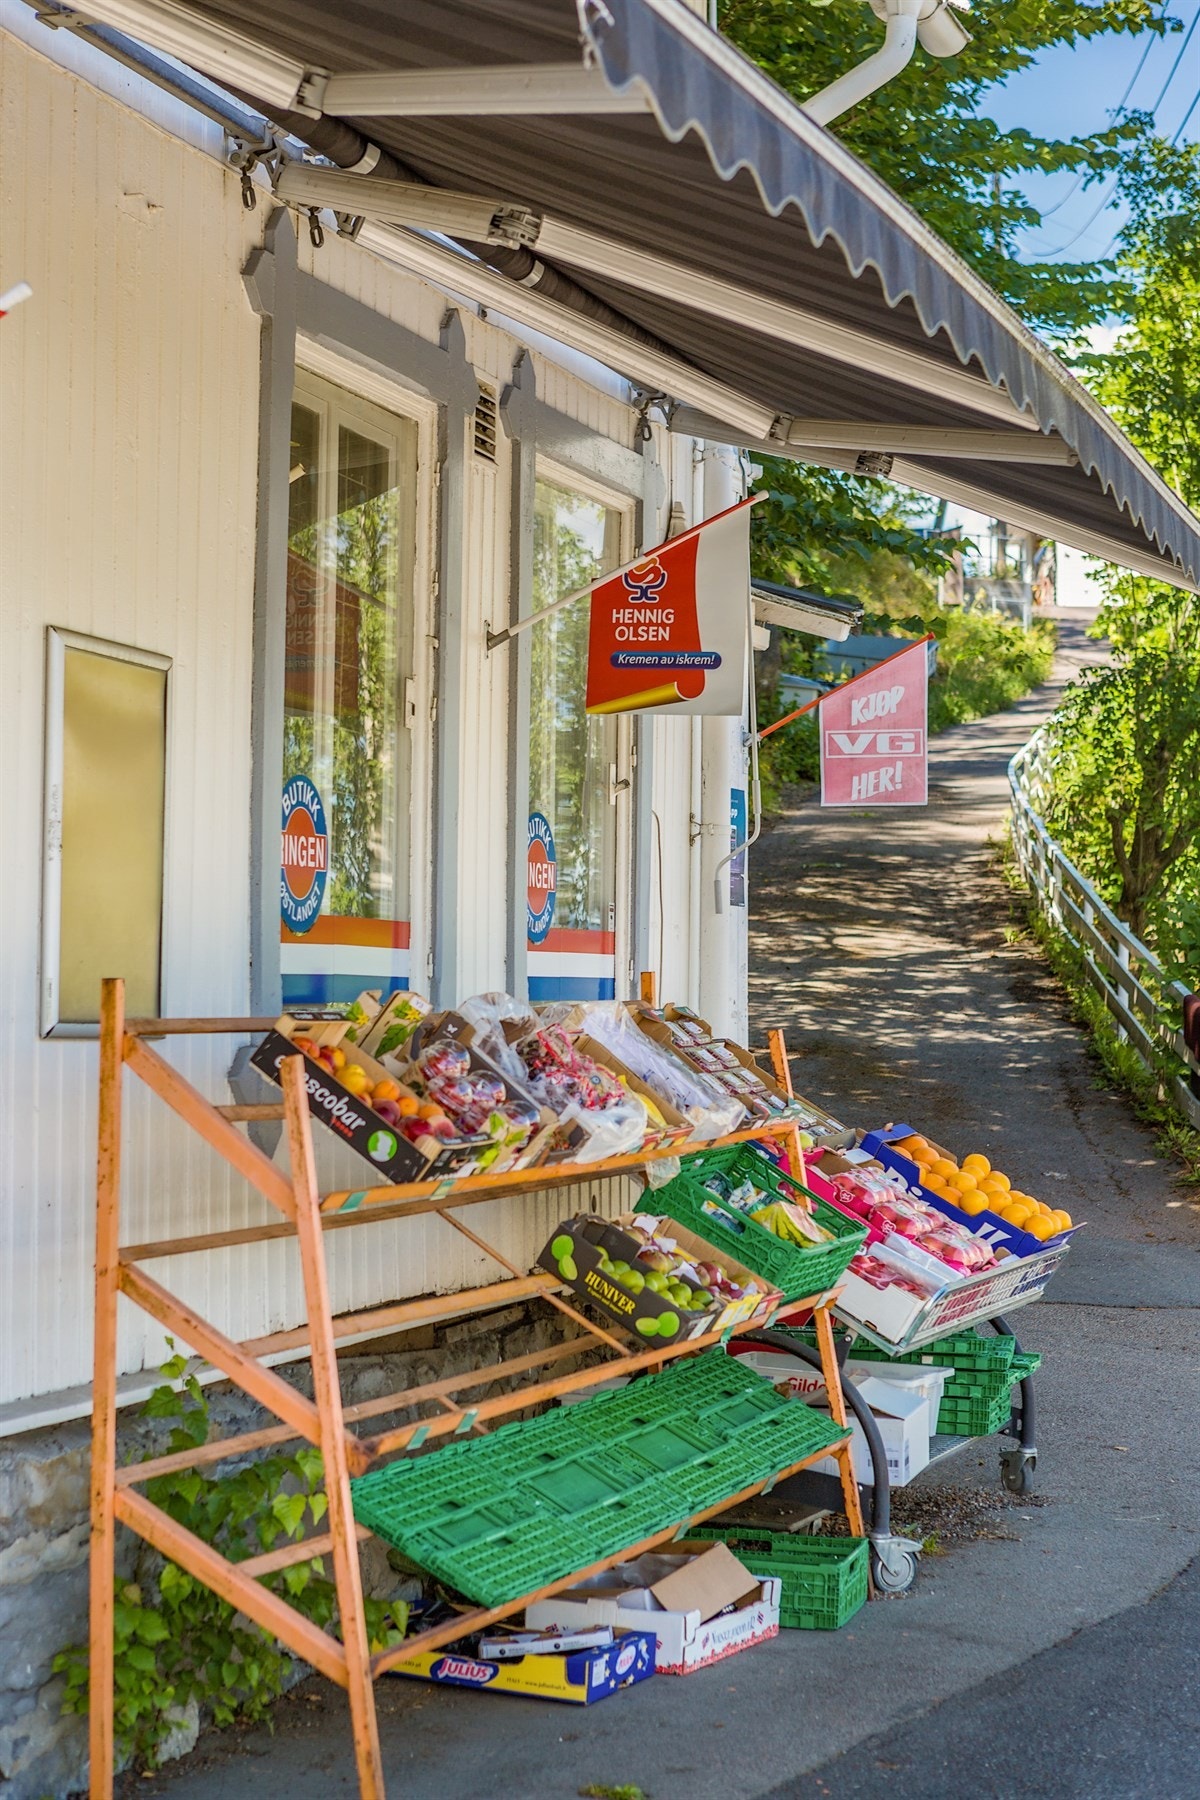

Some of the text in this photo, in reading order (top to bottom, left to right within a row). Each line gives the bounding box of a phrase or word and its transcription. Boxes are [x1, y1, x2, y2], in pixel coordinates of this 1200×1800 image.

[612, 608, 675, 624] HENNIG
[615, 626, 670, 641] OLSEN
[618, 653, 715, 665] Kremen av iskrem!
[851, 685, 905, 726] KJØP
[830, 733, 916, 754] VG
[851, 761, 903, 801] HER!
[282, 781, 321, 822] BUTIKK
[528, 817, 551, 851] UTIKK
[529, 862, 554, 890] NGEN
[528, 900, 551, 934] TLANDET
[585, 1270, 636, 1315] HUNIVER
